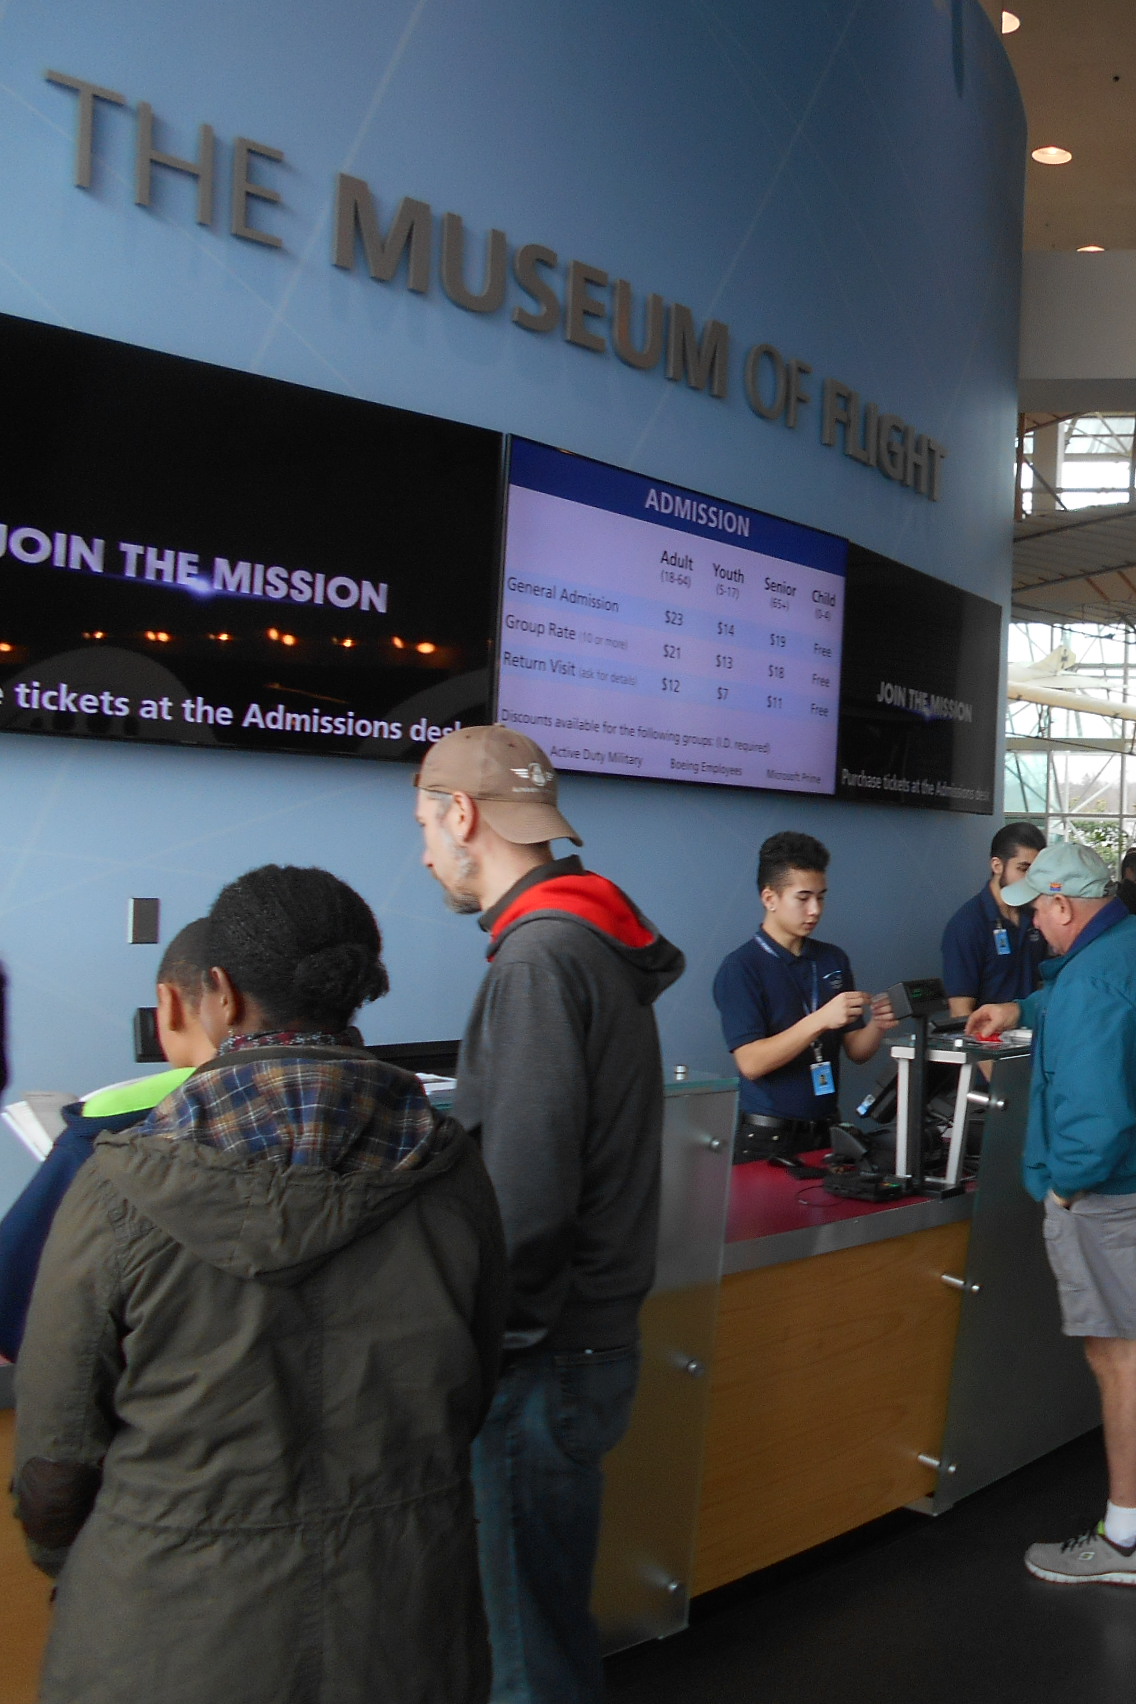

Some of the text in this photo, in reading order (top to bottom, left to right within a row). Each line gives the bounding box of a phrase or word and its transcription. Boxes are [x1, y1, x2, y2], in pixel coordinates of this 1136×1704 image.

[46, 69, 947, 502] THE MUSEUM OF FLIGHT
[645, 488, 750, 538] ADMISSION
[119, 542, 199, 585] THE
[213, 557, 388, 613] MISSION
[660, 550, 836, 607] Adult Youth Senior Child
[661, 570, 692, 589] (18-64)
[716, 583, 740, 600] (5-17)
[507, 577, 832, 658] General Admission $23 $14 $19 Free
[505, 614, 545, 637] Group
[549, 622, 576, 640] Rate
[663, 644, 681, 660] $21
[716, 654, 733, 669] $13
[768, 664, 785, 679] $18
[812, 673, 831, 688] Free
[14, 681, 130, 716] tickets
[139, 697, 173, 721] at
[181, 697, 234, 726] the
[242, 703, 402, 740] Admissions
[410, 717, 461, 743] des
[503, 651, 546, 671] Return
[550, 658, 576, 676] Visit
[662, 677, 680, 693] $12
[717, 687, 729, 700] $7
[767, 695, 783, 709] $11
[810, 703, 829, 717] Free
[877, 681, 973, 722] JOIN THE MISSION
[501, 709, 552, 727] Discounts
[555, 717, 600, 733] available
[602, 721, 617, 735] for
[619, 724, 635, 737] the
[637, 726, 681, 745] following
[734, 741, 771, 755] required)
[550, 746, 821, 785] Active Duty Military Boeing Employees Microsoft Prime
[841, 768, 883, 789] Purchase
[883, 773, 910, 792] tickets
[921, 779, 935, 796] the
